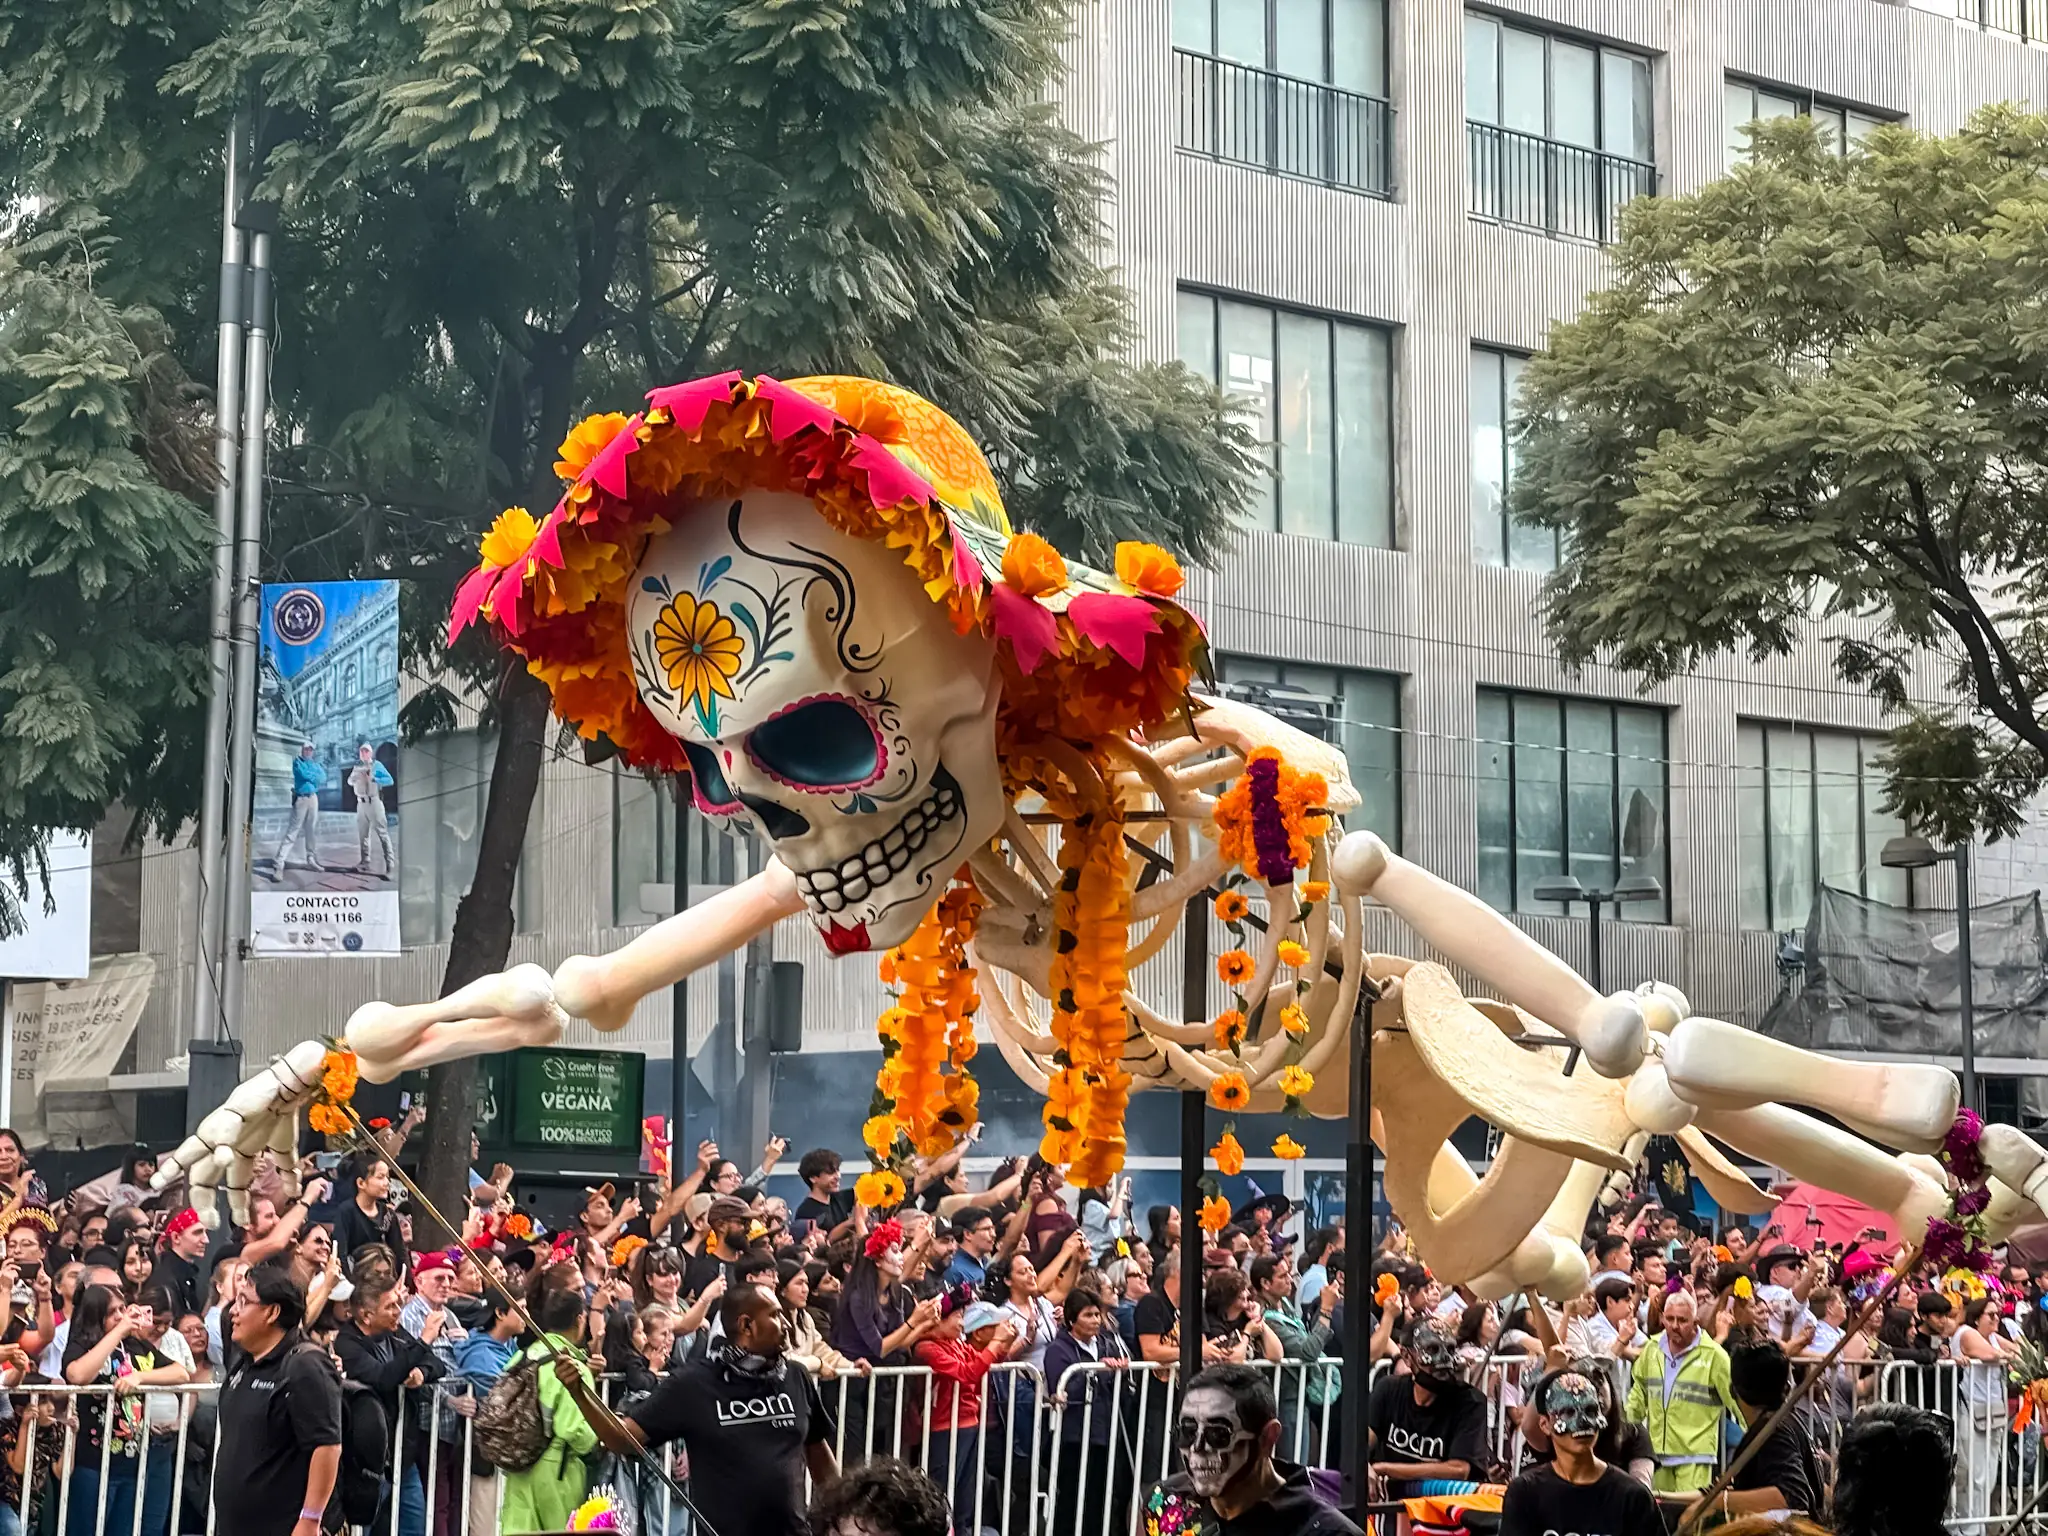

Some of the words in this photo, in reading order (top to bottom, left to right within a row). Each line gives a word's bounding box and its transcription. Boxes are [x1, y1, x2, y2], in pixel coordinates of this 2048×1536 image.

[286, 896, 359, 908] CONTACTO
[283, 912, 298, 923] 55
[301, 912, 328, 923] 4891
[334, 912, 362, 923] 1166
[567, 1062, 596, 1075] Cruelty
[541, 1091, 613, 1111] VEGANA
[540, 1127, 575, 1142] 100%
